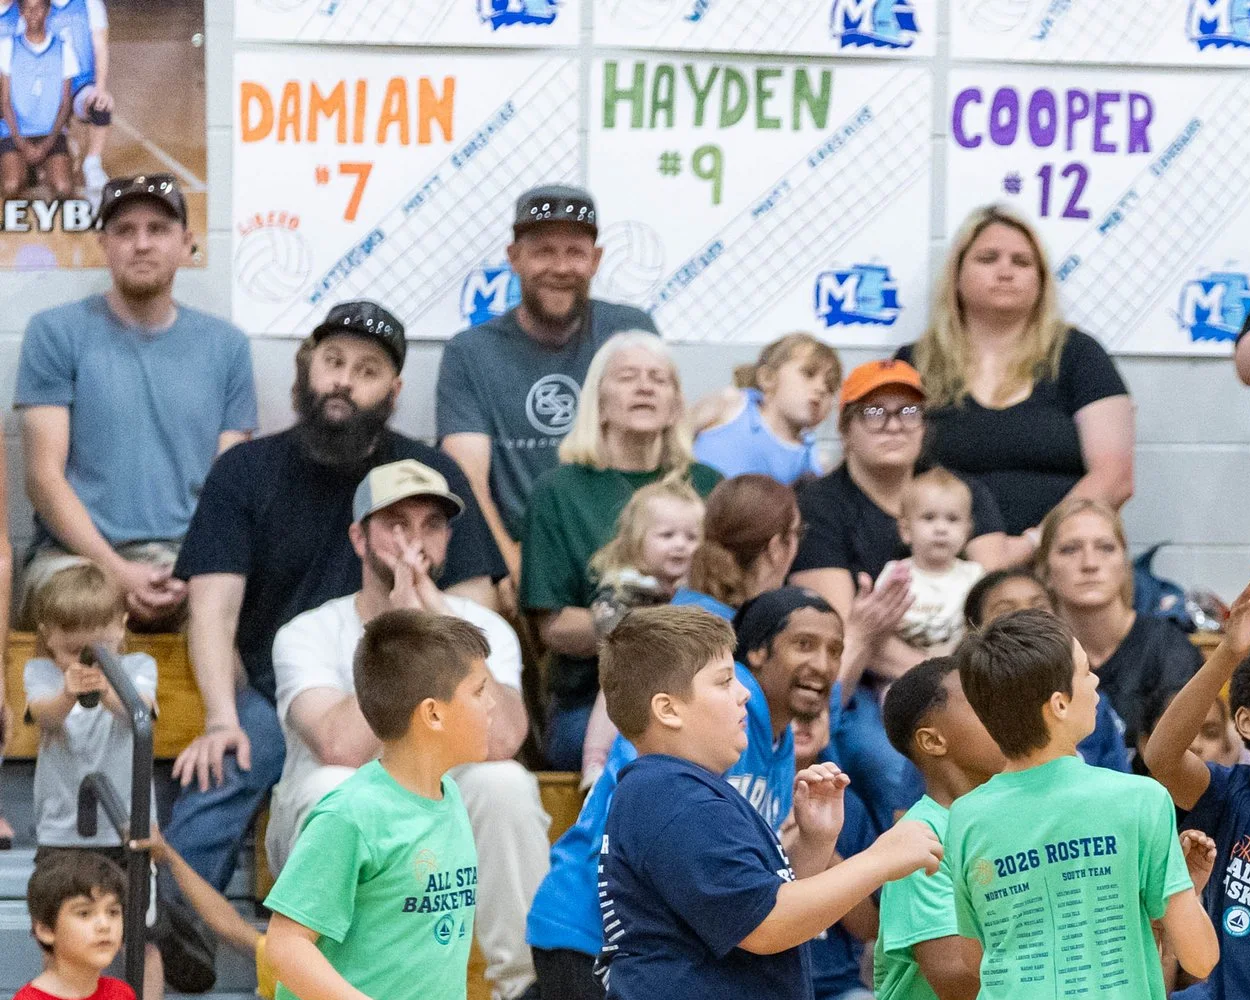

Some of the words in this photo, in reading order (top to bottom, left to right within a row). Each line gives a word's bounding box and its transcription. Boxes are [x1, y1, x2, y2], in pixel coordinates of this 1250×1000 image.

[240, 75, 456, 147] DAMIAN
[602, 58, 835, 131] HAYDEN
[951, 87, 1155, 154] COOPER
[315, 161, 375, 223] #7
[658, 144, 724, 206] #9
[1002, 161, 1092, 220] #12
[0, 199, 104, 233] EYB
[425, 871, 451, 893] ALL
[993, 849, 1041, 878] 2026
[1044, 835, 1118, 865] ROSTER
[1062, 869, 1086, 882] SOUTH
[1088, 866, 1112, 877] TEAM
[984, 887, 1009, 903] NORTH
[1009, 882, 1030, 895] TEAM
